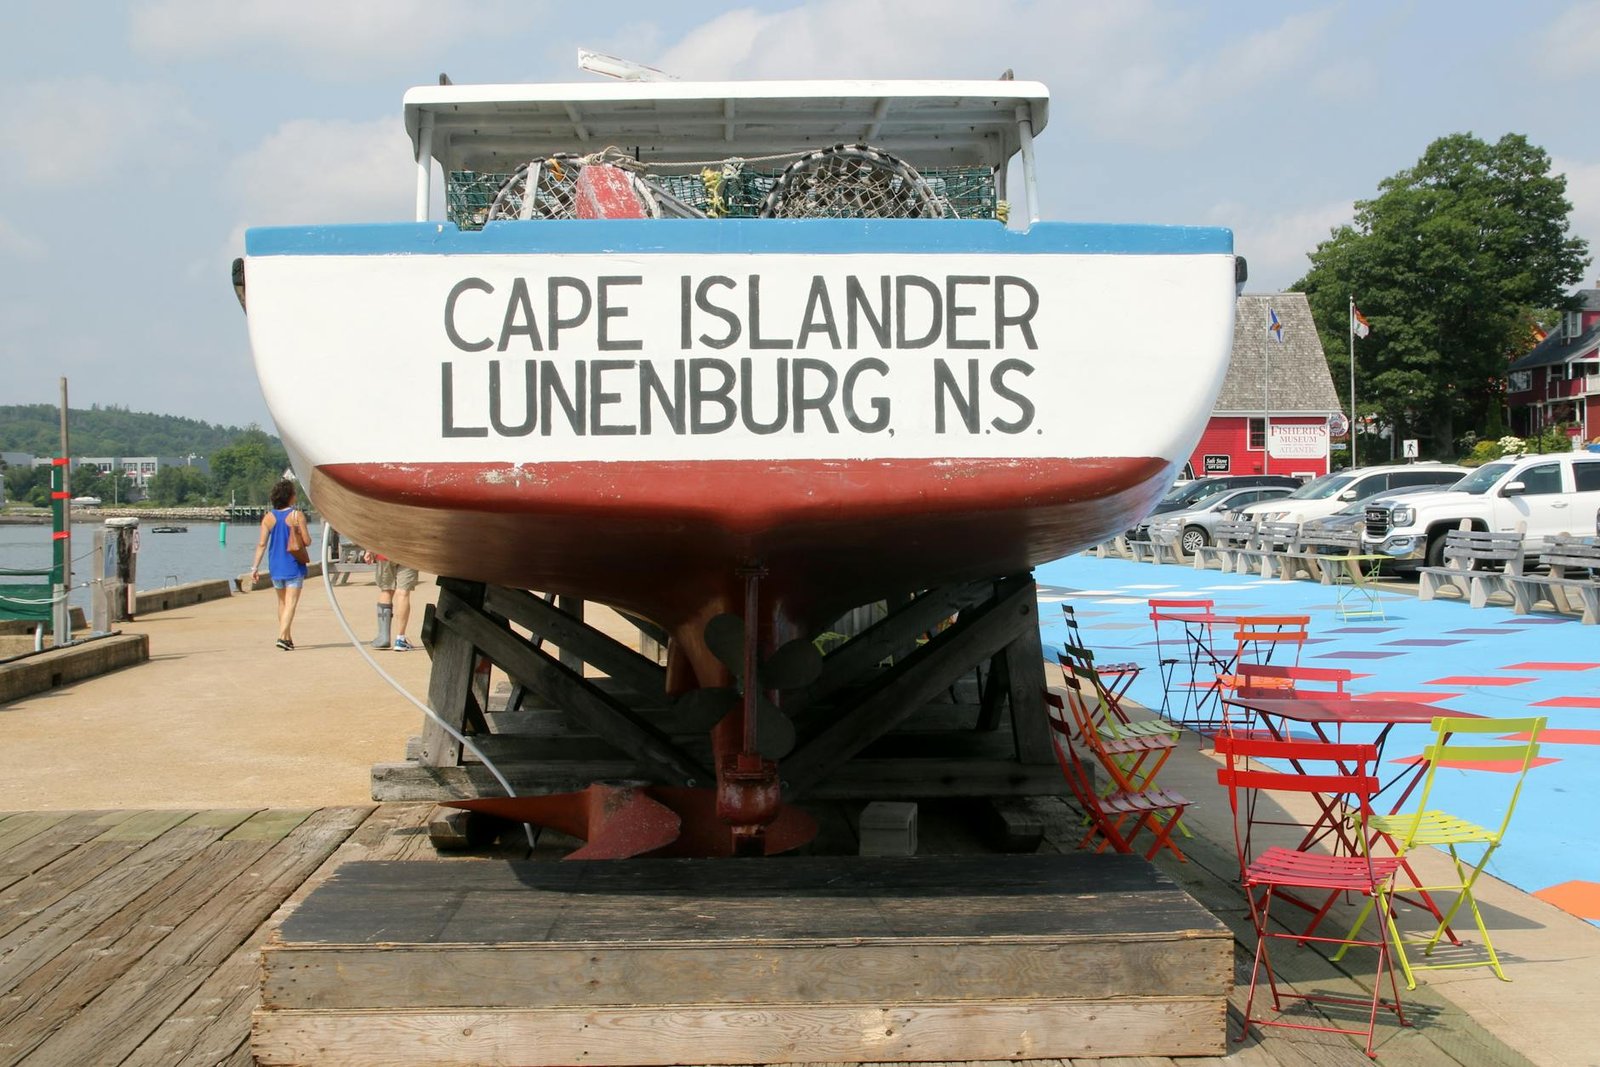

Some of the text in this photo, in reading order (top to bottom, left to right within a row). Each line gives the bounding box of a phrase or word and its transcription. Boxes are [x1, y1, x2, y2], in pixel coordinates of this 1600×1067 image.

[445, 274, 1039, 352] CAPE ISLANDER
[442, 357, 1043, 438] LUNENBURG, N.S.
[1271, 426, 1326, 437] FISHERIES
